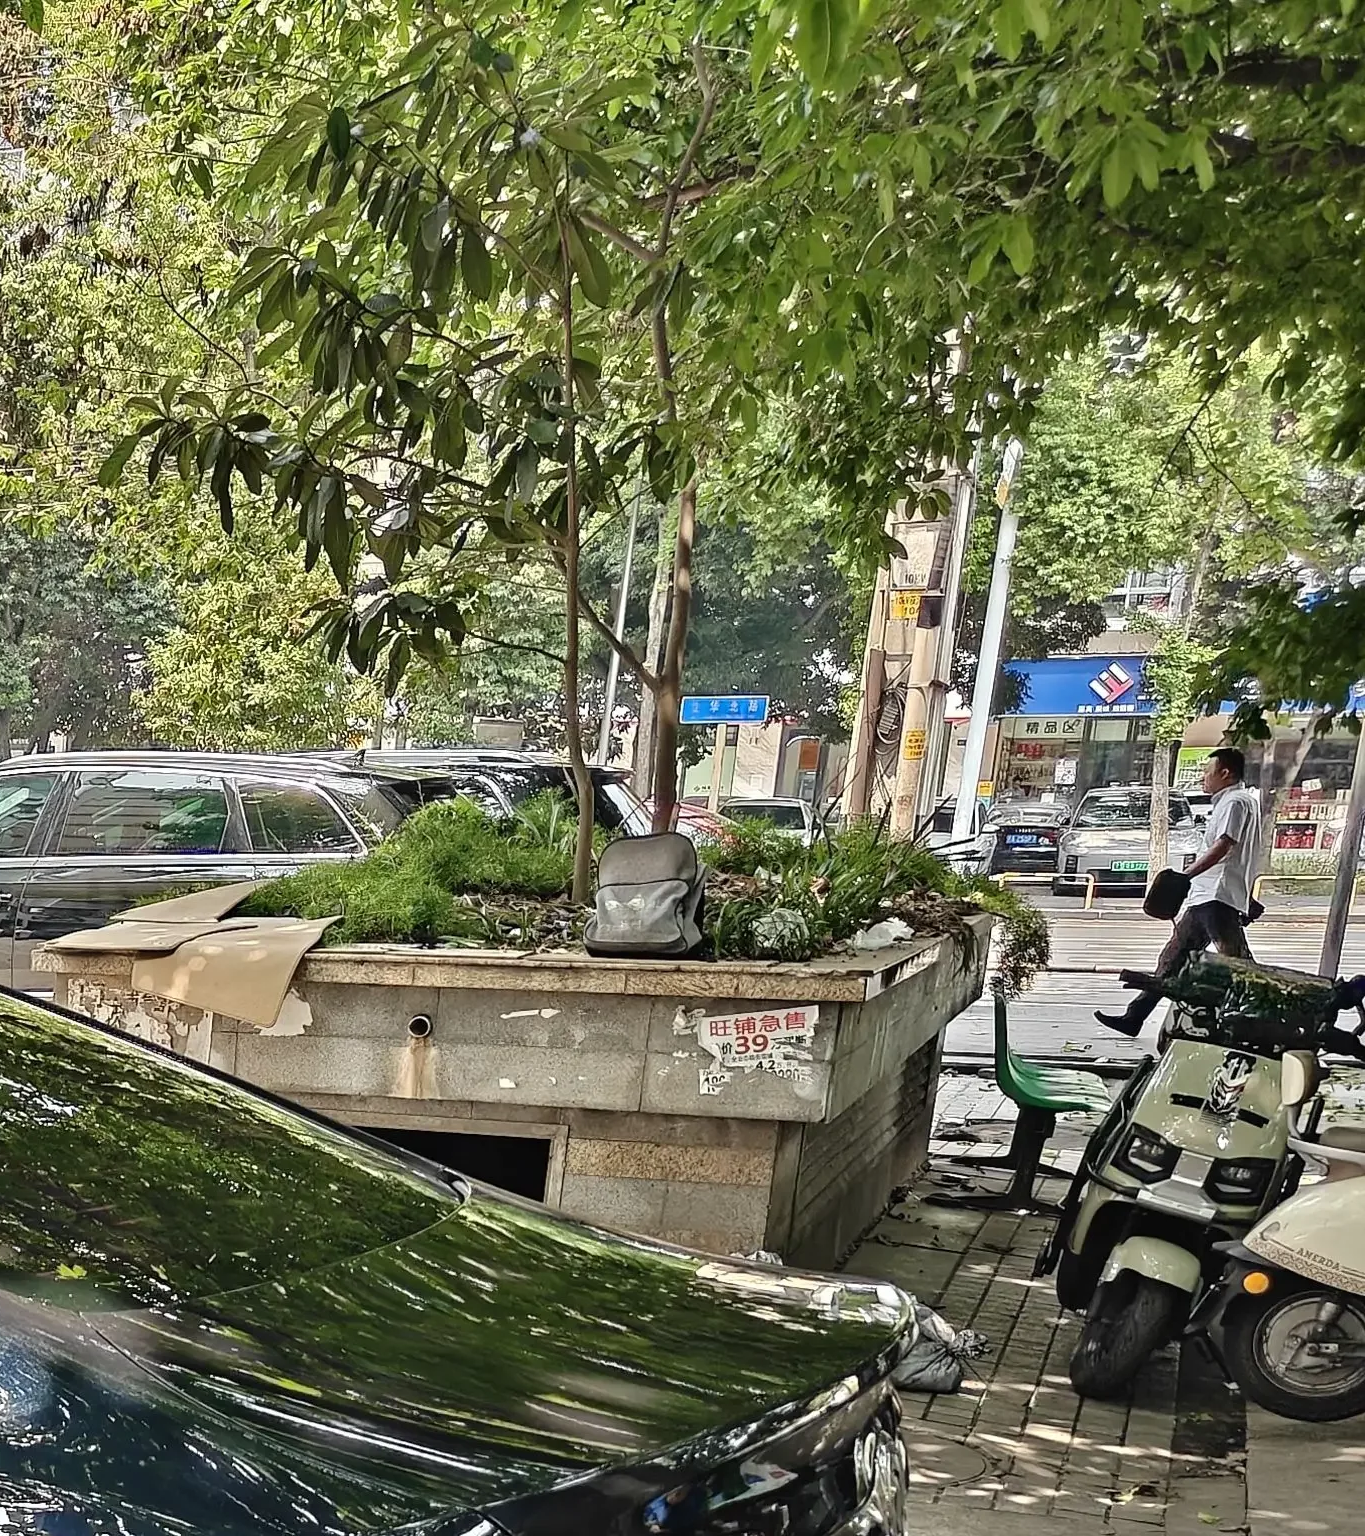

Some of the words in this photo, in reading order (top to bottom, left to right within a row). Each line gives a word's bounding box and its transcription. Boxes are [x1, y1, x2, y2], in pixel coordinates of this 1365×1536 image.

[1026, 721, 1074, 734] 精品区
[709, 1011, 806, 1037] 旺铺急售
